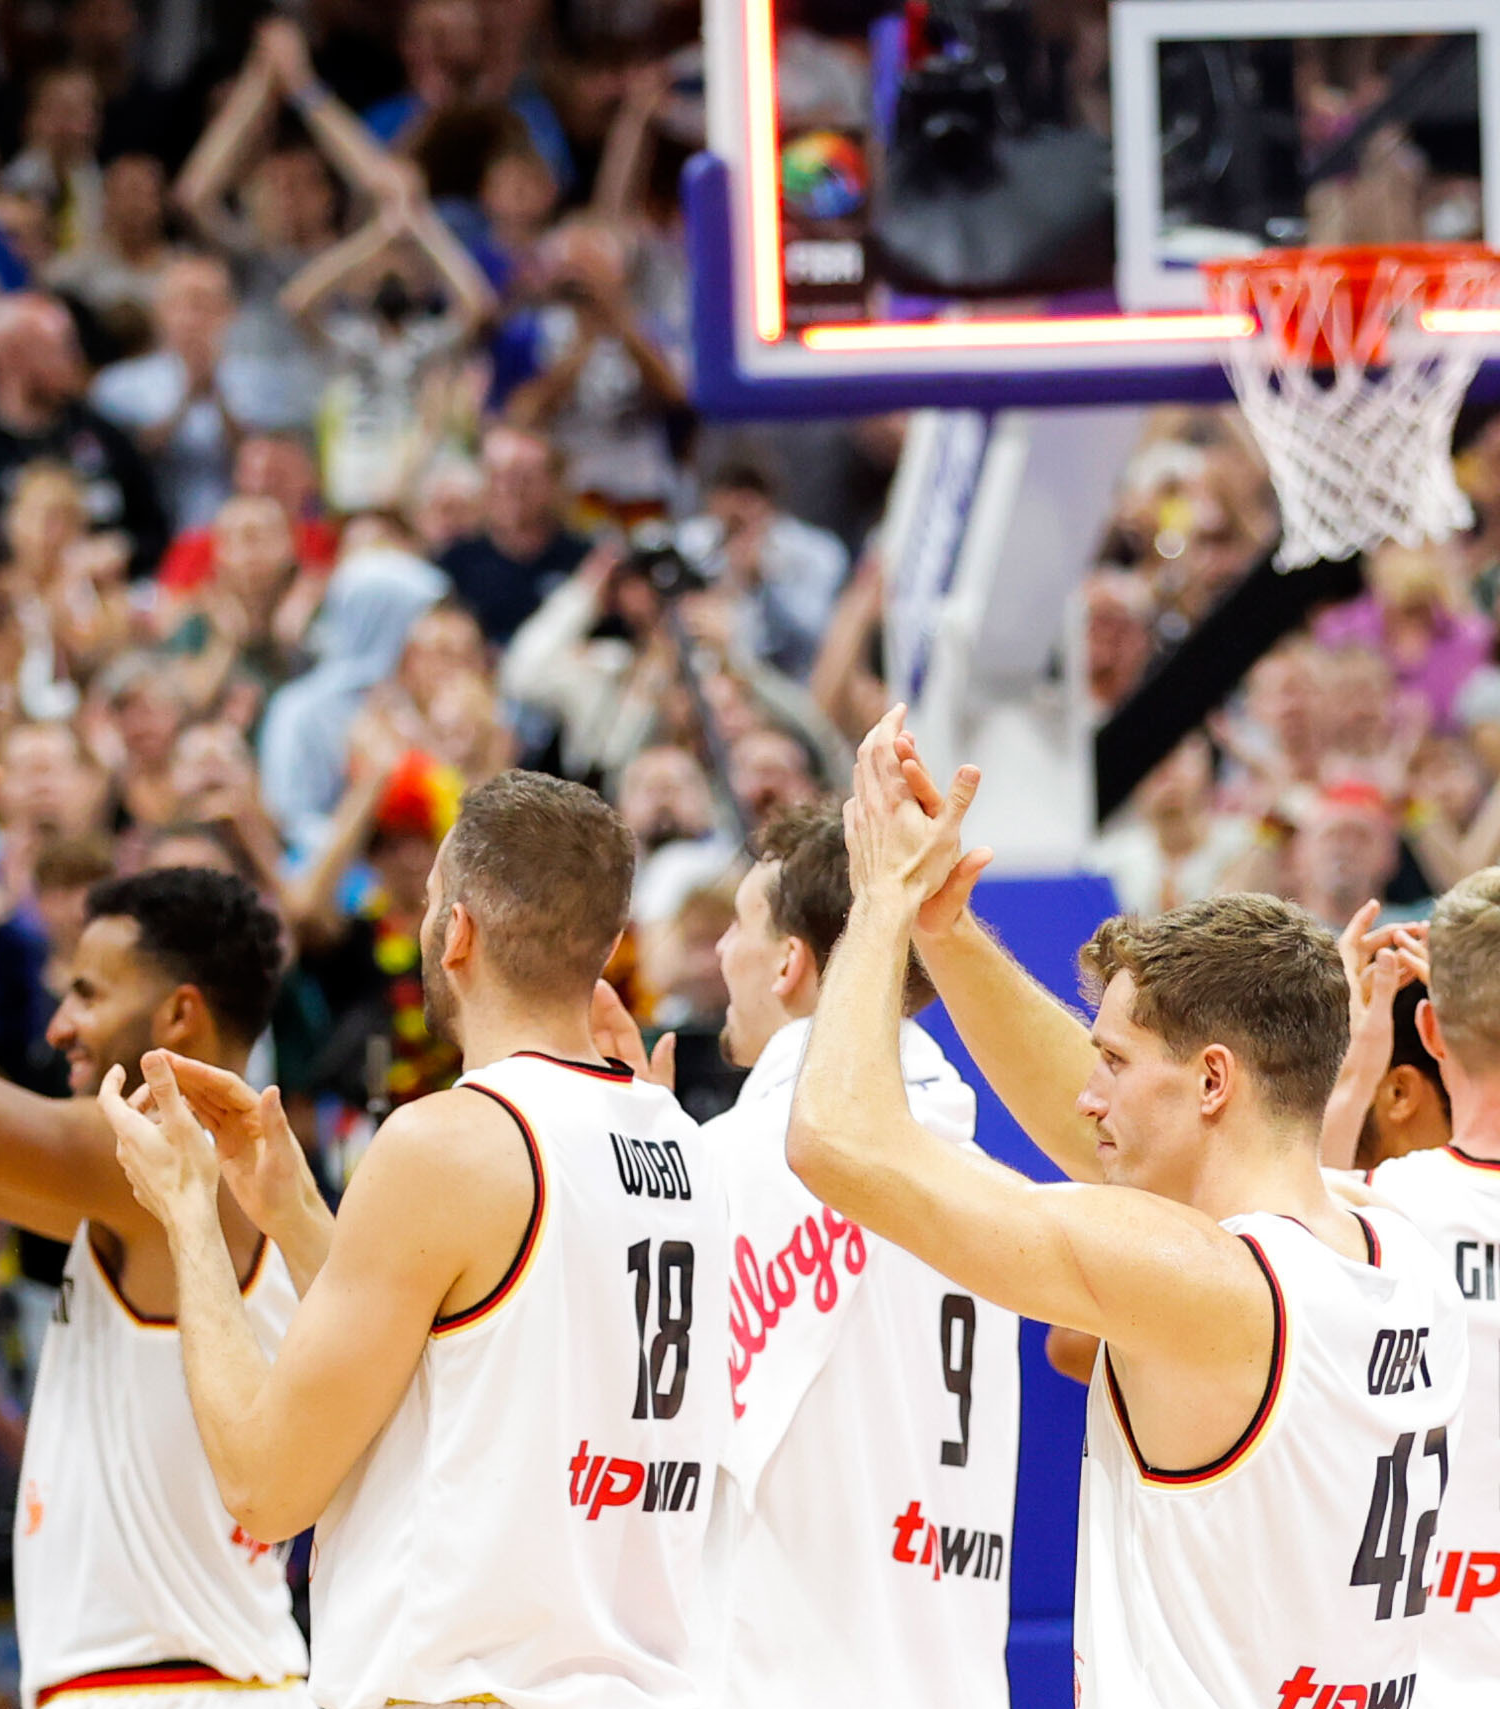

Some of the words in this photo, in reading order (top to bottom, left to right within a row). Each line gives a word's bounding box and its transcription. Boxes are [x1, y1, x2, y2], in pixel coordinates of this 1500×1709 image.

[609, 1132, 692, 1200] WOBO
[627, 1237, 695, 1419] 18
[940, 1293, 977, 1467] 9
[1349, 1425, 1449, 1622] 42
